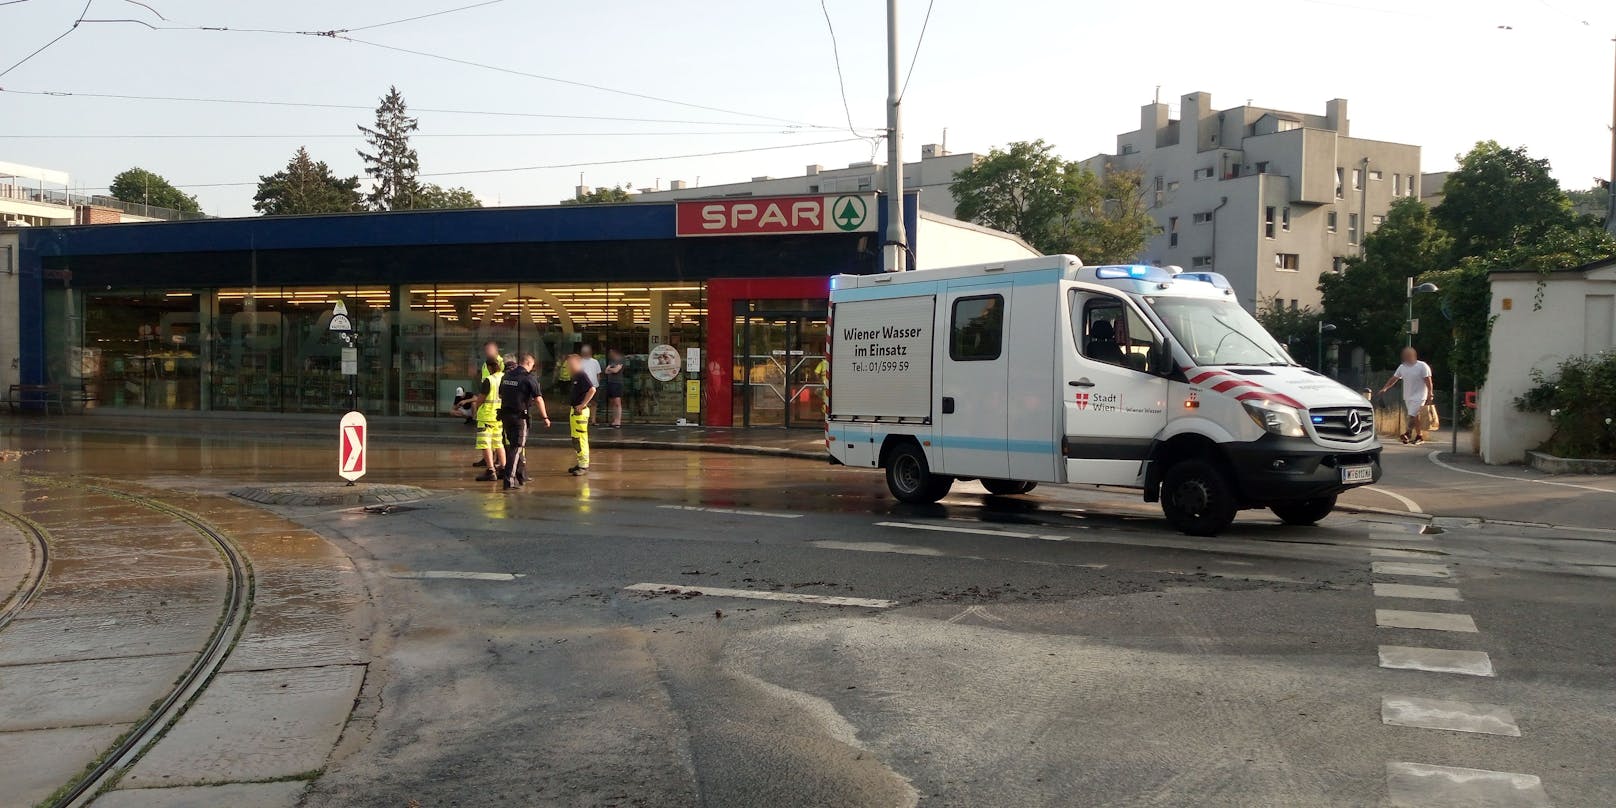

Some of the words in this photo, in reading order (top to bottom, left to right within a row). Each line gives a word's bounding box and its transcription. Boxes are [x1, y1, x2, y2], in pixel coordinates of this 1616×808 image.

[702, 202, 820, 230] SPAR
[843, 328, 880, 341] Wiener
[883, 326, 922, 339] Wasser
[855, 344, 867, 357] im
[870, 344, 907, 356] Einsatz
[852, 362, 868, 373] Tel.:
[869, 361, 897, 374] 01/599
[898, 361, 910, 372] 59
[1093, 393, 1116, 402] Stadt
[1093, 402, 1116, 412] Wien
